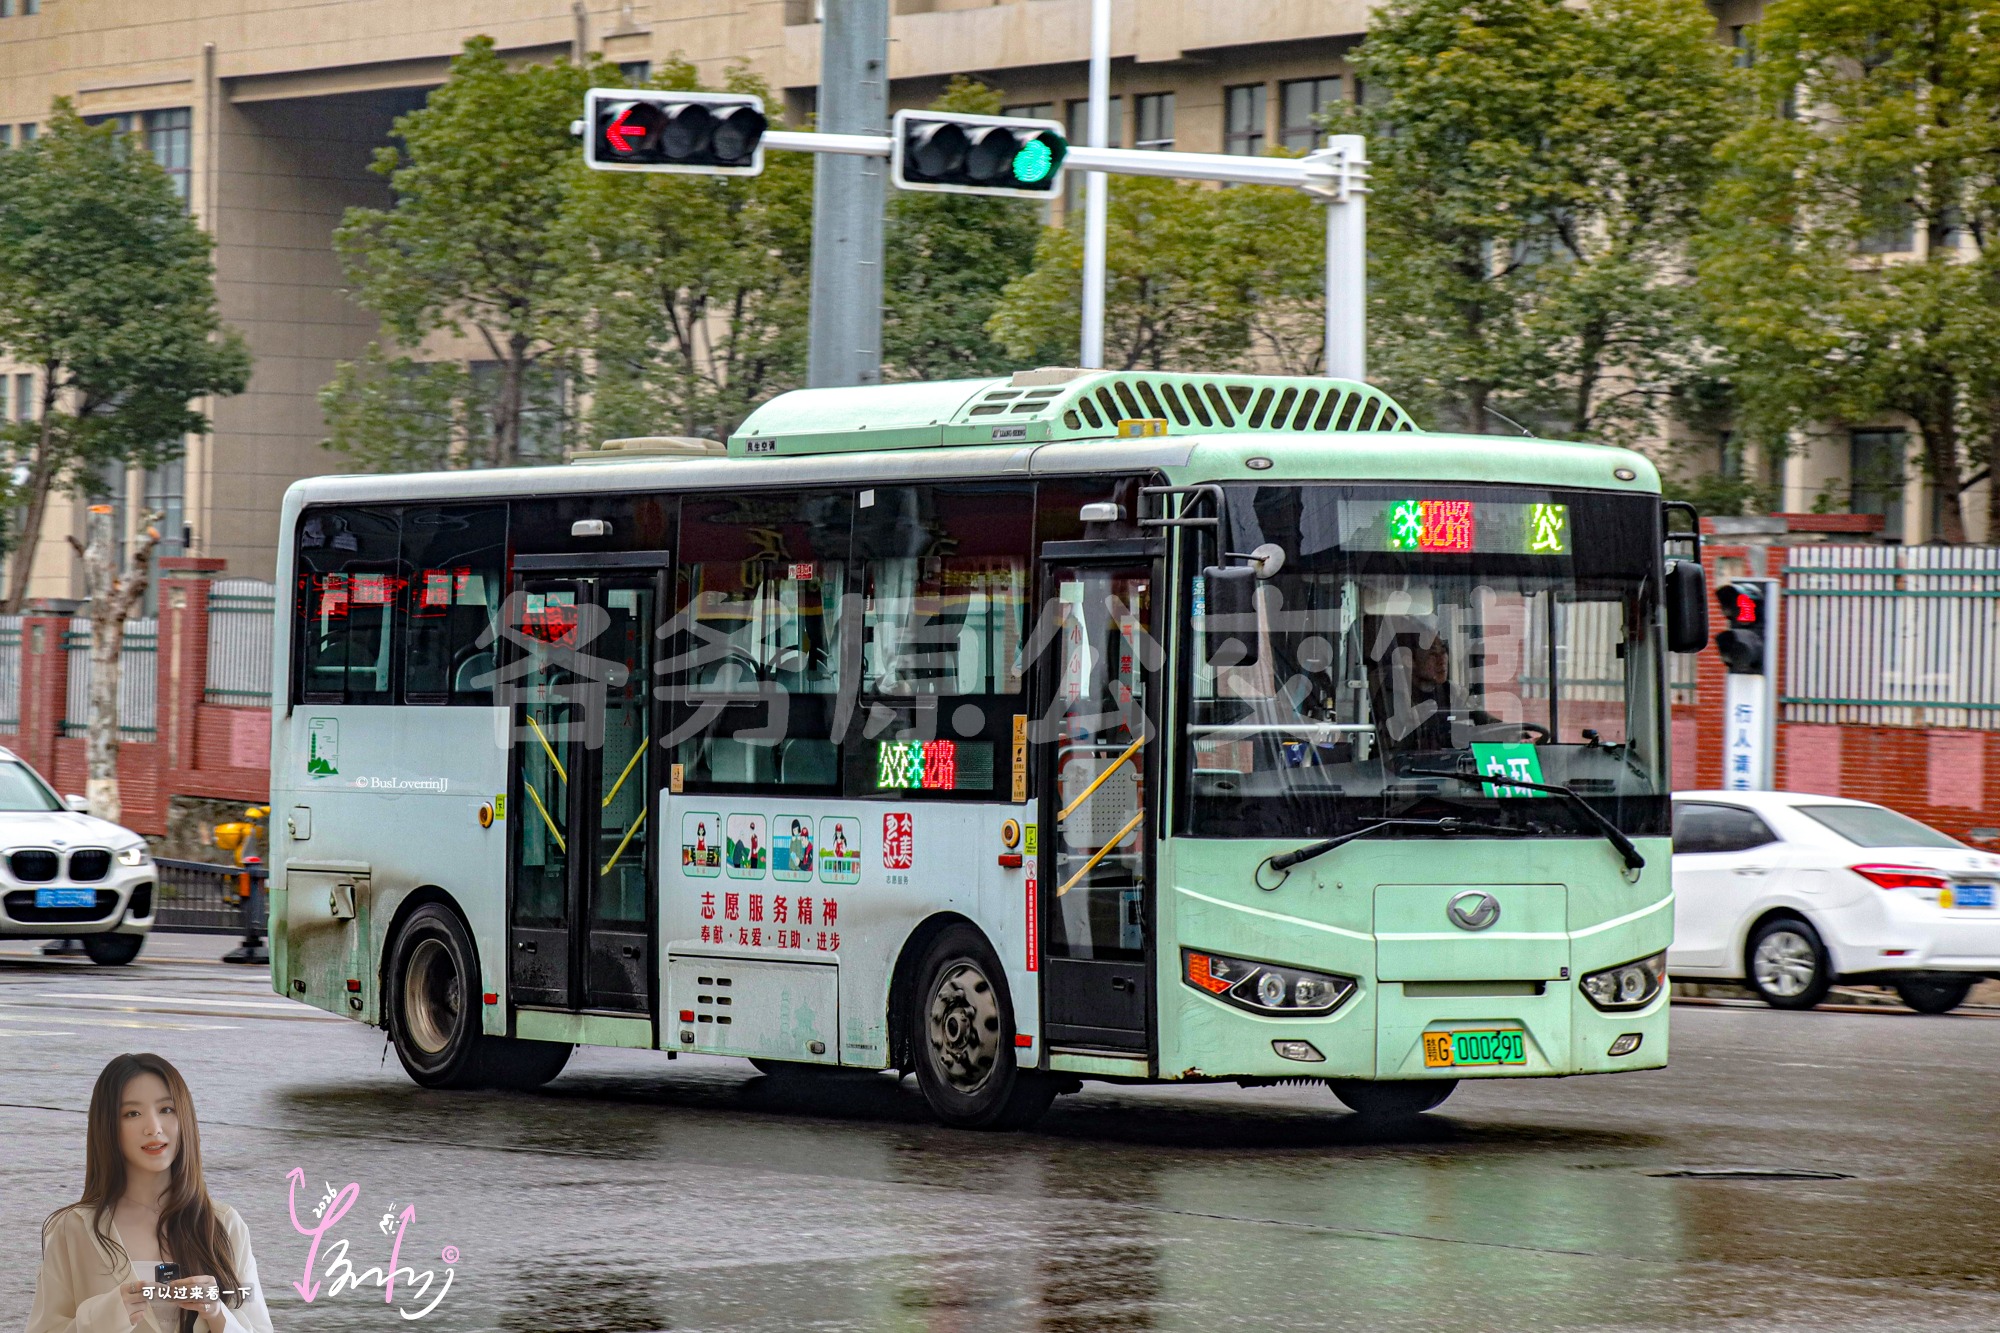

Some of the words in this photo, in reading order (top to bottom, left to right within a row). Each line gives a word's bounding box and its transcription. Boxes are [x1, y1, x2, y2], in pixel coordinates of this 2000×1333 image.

[700, 891, 838, 927] 志愿服务精神
